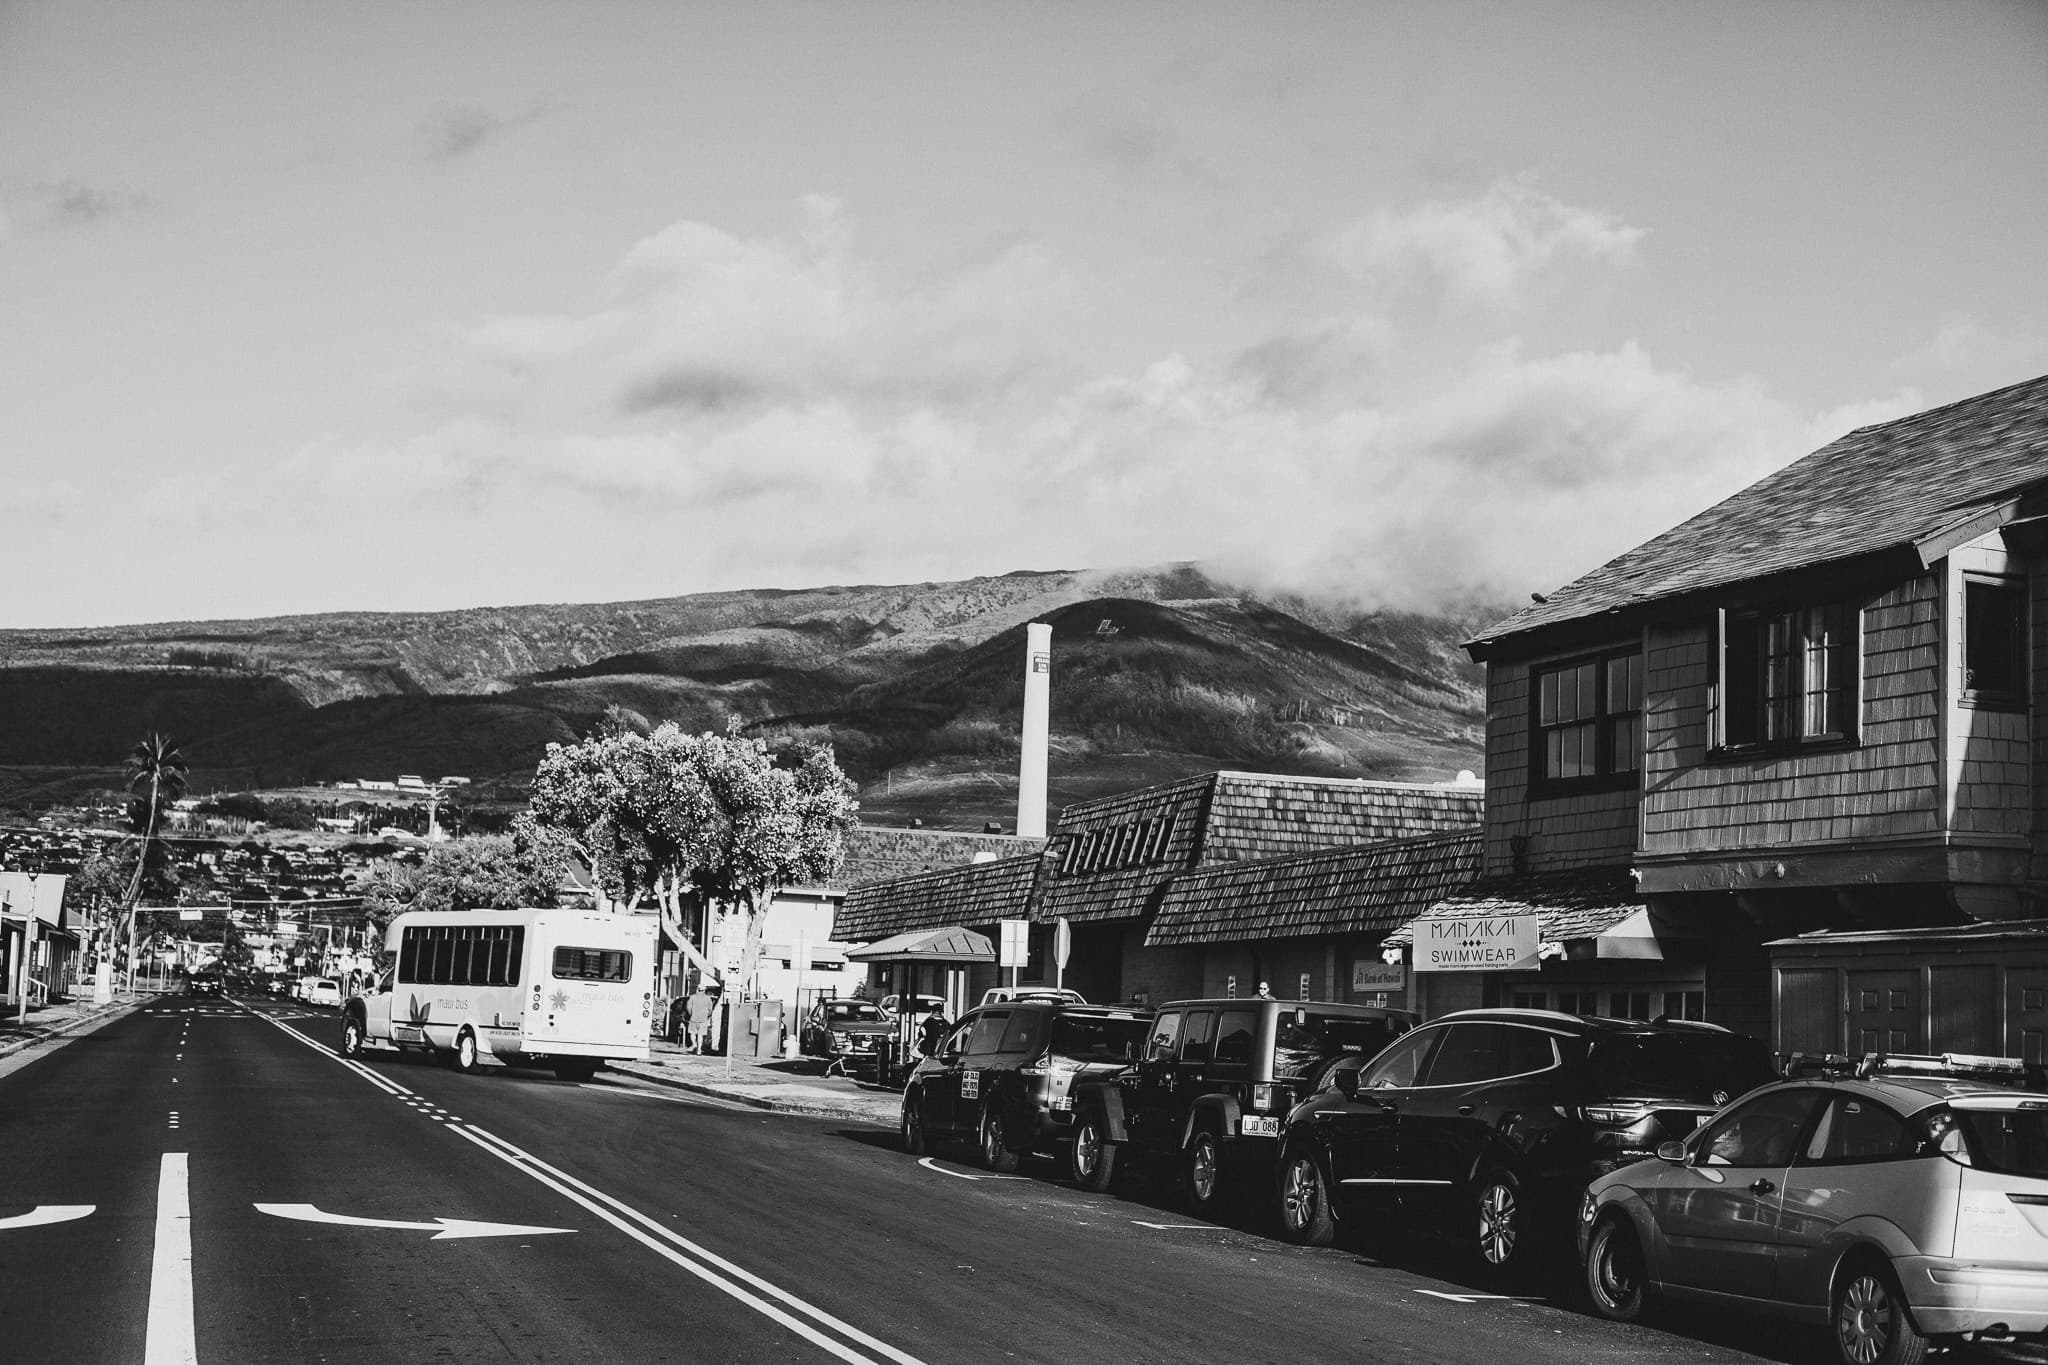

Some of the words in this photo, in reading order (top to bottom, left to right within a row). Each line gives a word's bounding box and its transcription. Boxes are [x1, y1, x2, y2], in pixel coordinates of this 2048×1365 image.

[1431, 919, 1515, 938] MANAKAI
[1431, 948, 1516, 963] SWIMWEAR
[456, 997, 469, 1010] bus
[1262, 1121, 1277, 1133] 088
